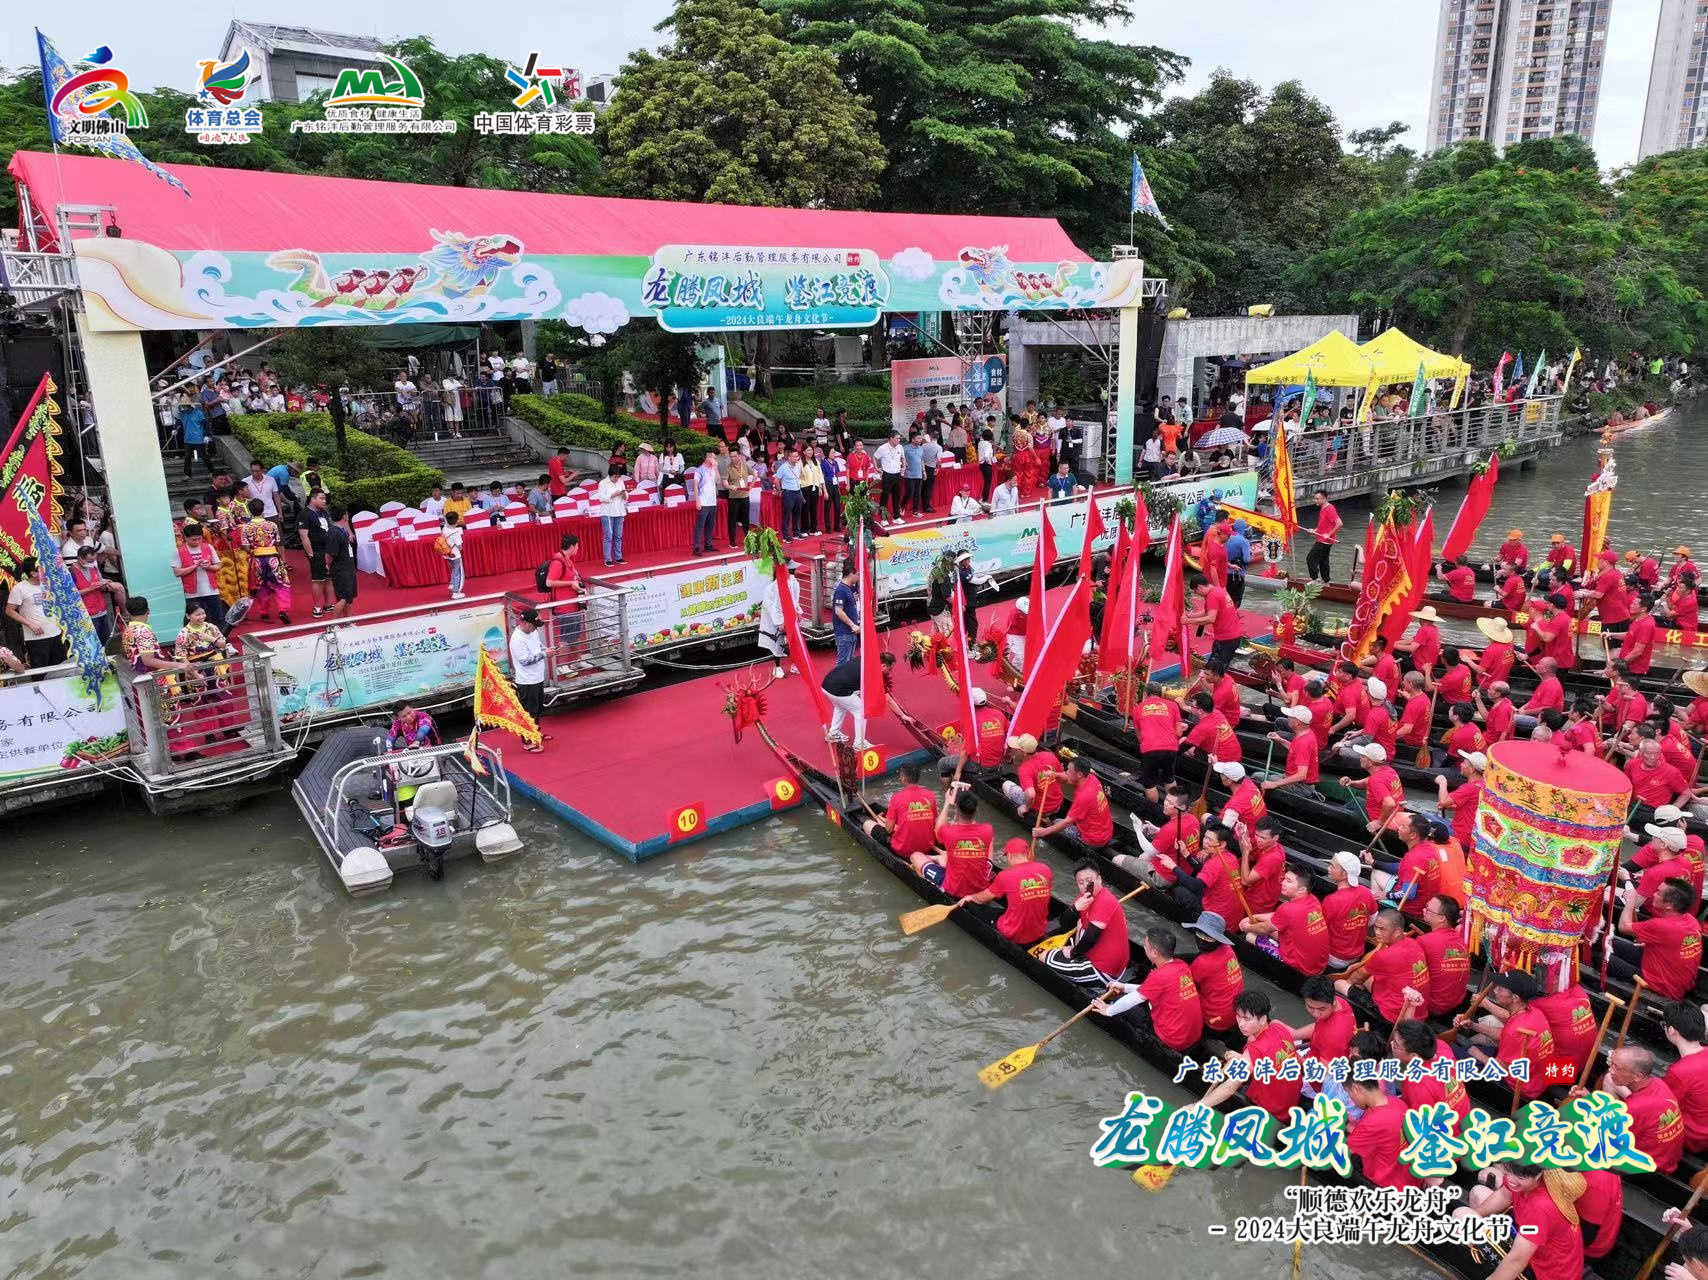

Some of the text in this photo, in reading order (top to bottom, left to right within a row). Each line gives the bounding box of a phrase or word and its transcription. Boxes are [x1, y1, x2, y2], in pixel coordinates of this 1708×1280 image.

[643, 267, 765, 308] 龙腾凤城
[679, 811, 697, 828] 10
